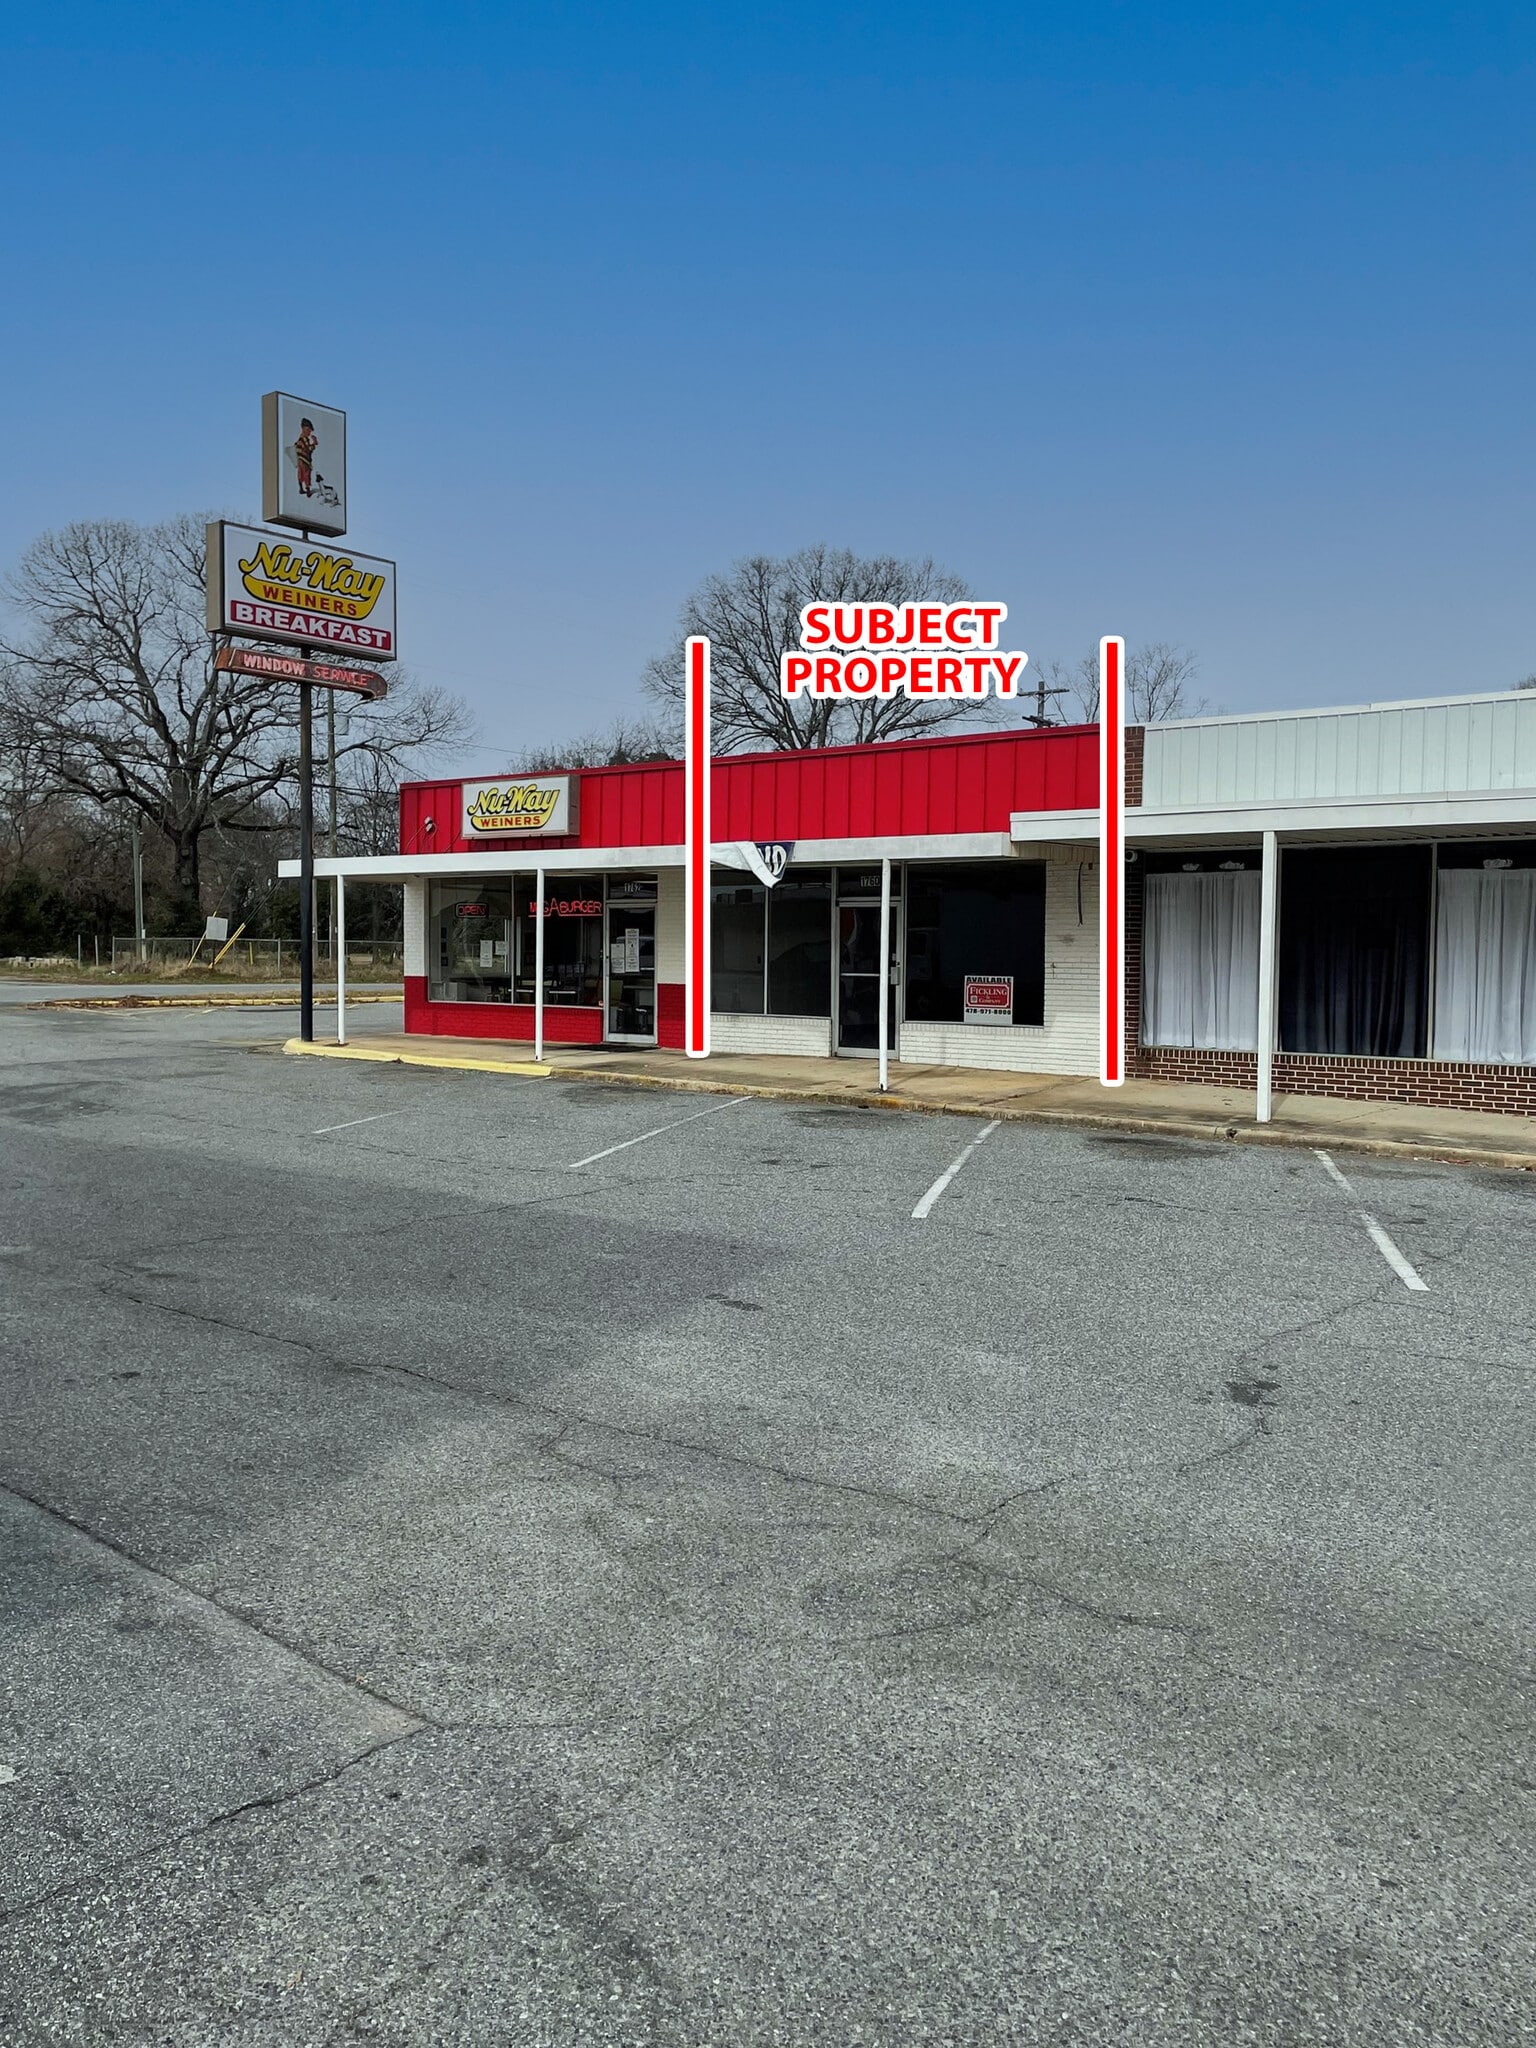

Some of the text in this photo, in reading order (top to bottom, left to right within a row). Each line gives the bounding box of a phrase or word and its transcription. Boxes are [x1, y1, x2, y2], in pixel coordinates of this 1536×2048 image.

[239, 542, 385, 600] Nu-Way
[263, 585, 357, 616] WEINERS
[235, 602, 387, 648] BREAKFAST
[243, 653, 371, 686] WINDOW SERVICE
[467, 784, 560, 815] Nu-Way
[480, 815, 541, 827] WEINERS
[860, 875, 880, 887] 1760
[458, 905, 486, 915] OPEN
